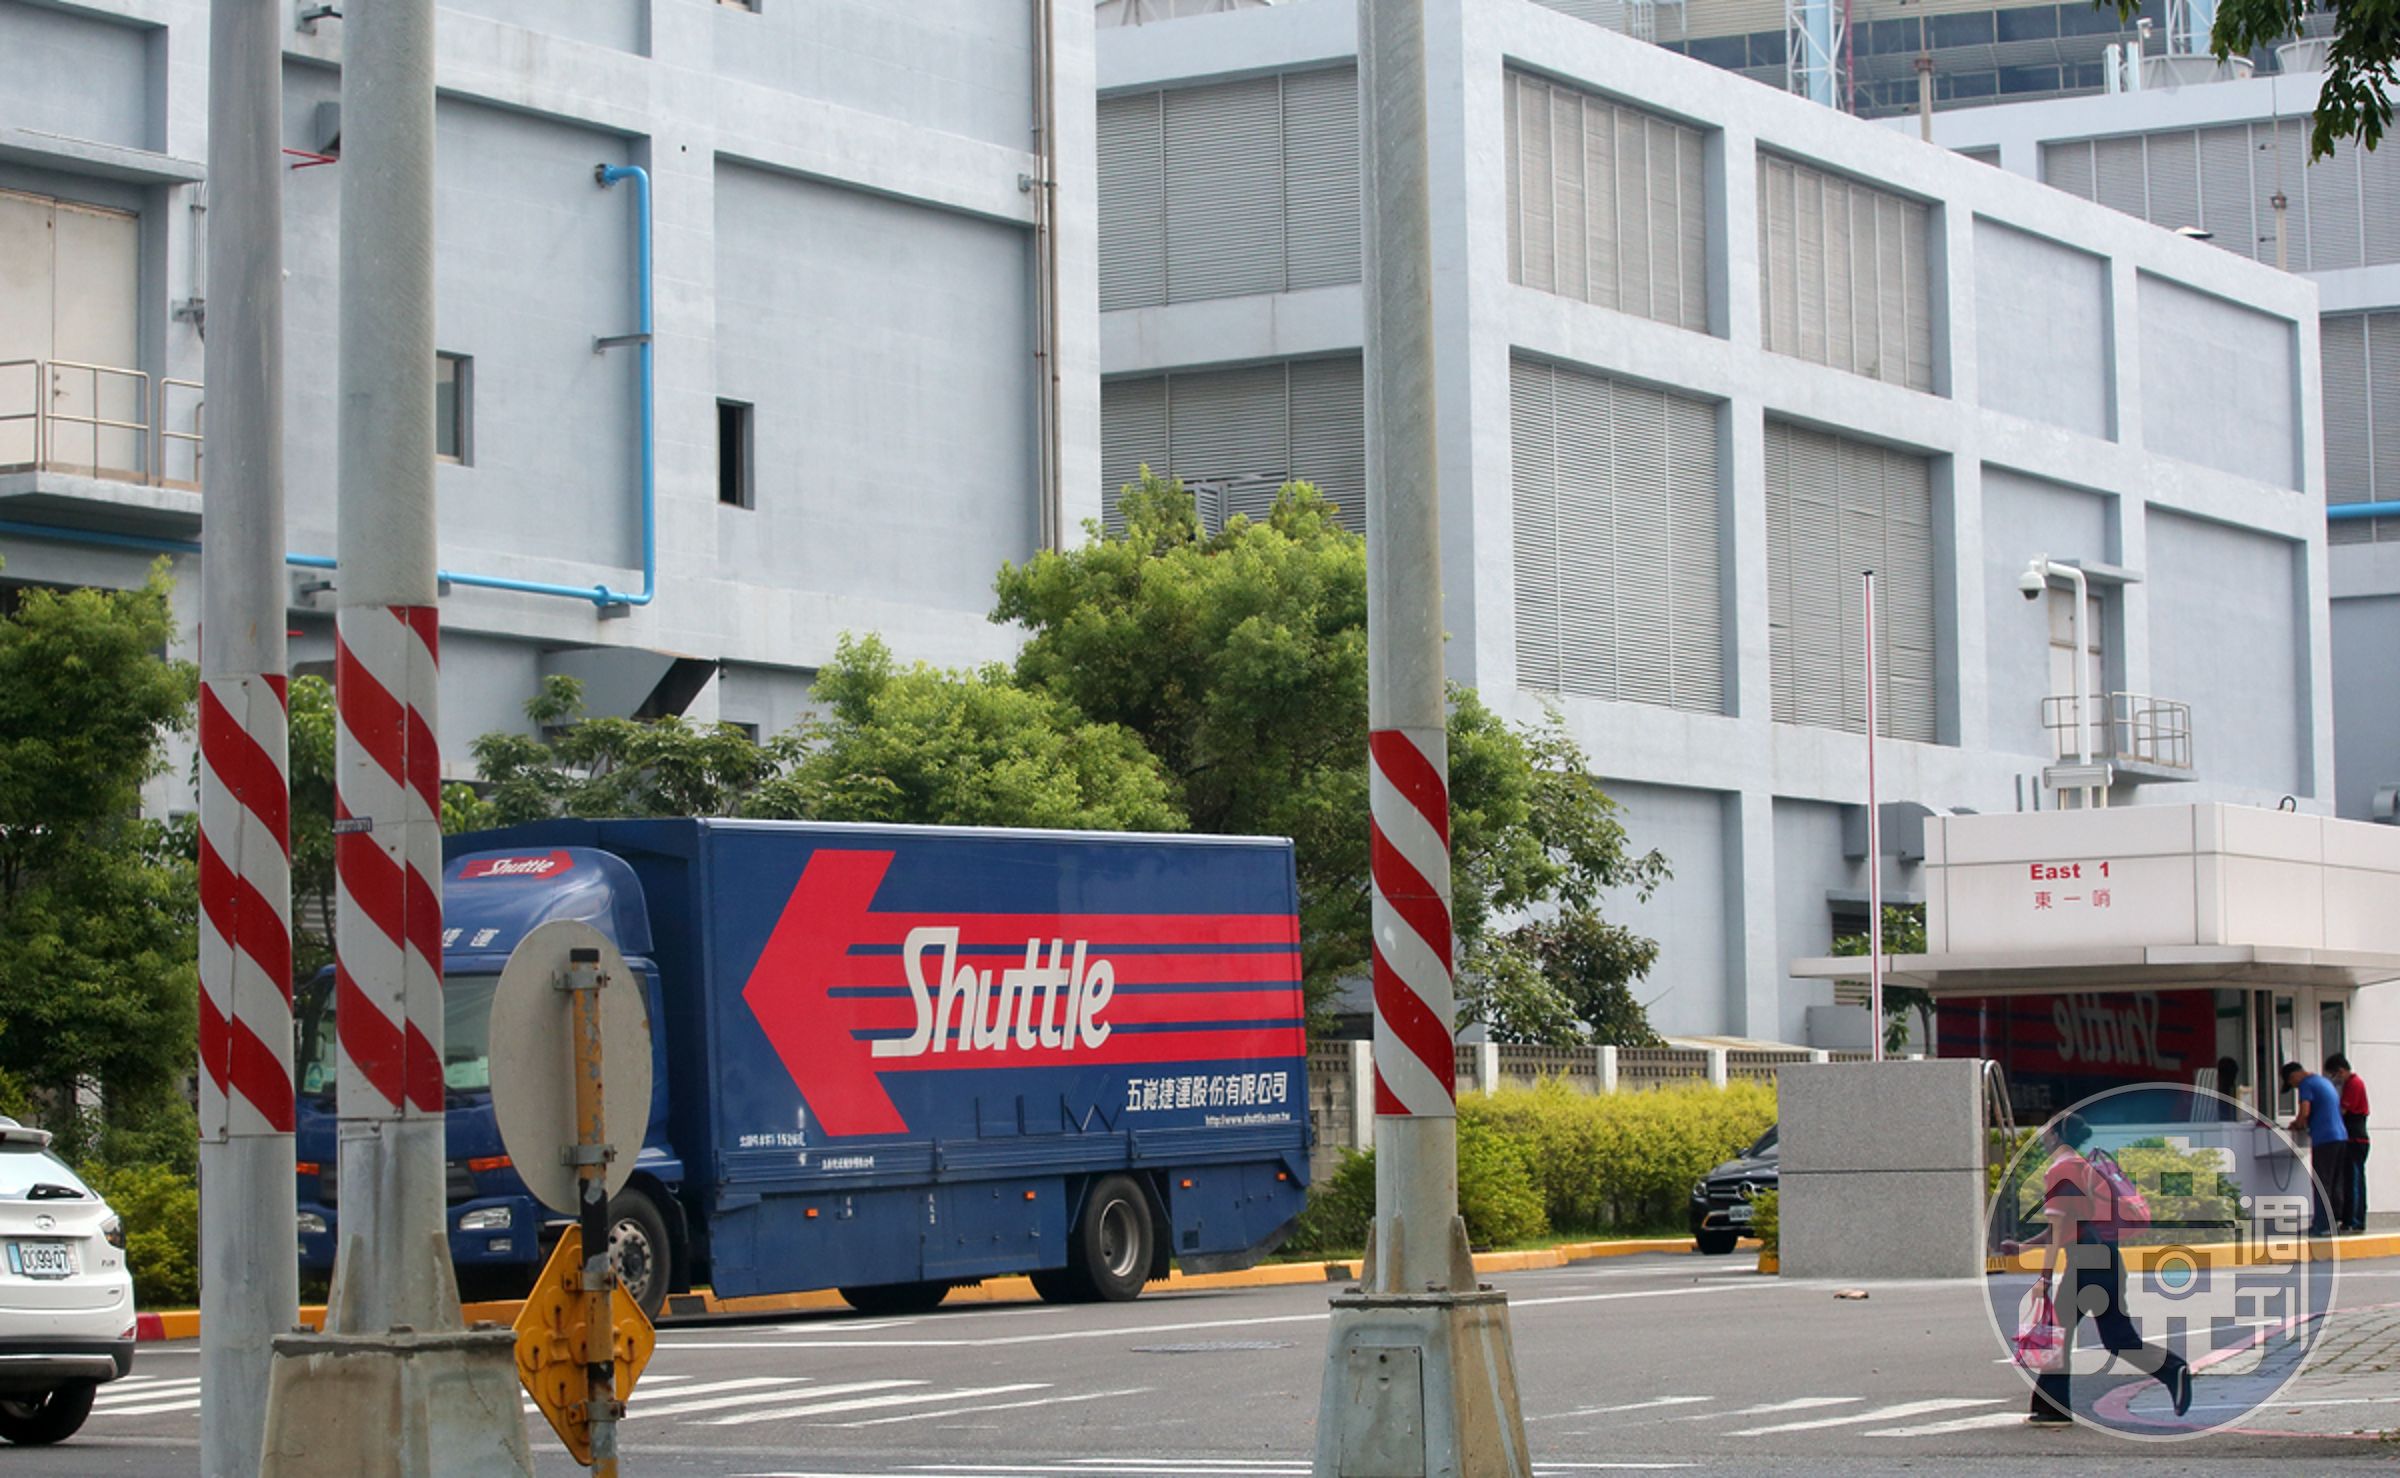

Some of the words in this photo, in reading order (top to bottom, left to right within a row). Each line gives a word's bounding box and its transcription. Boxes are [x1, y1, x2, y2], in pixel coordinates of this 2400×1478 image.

[477, 859, 555, 877] Shuttle
[2030, 863, 2081, 880] East
[2098, 861, 2109, 878] 1
[2034, 888, 2110, 909] 東一哨
[871, 926, 1115, 1058] Shuttle
